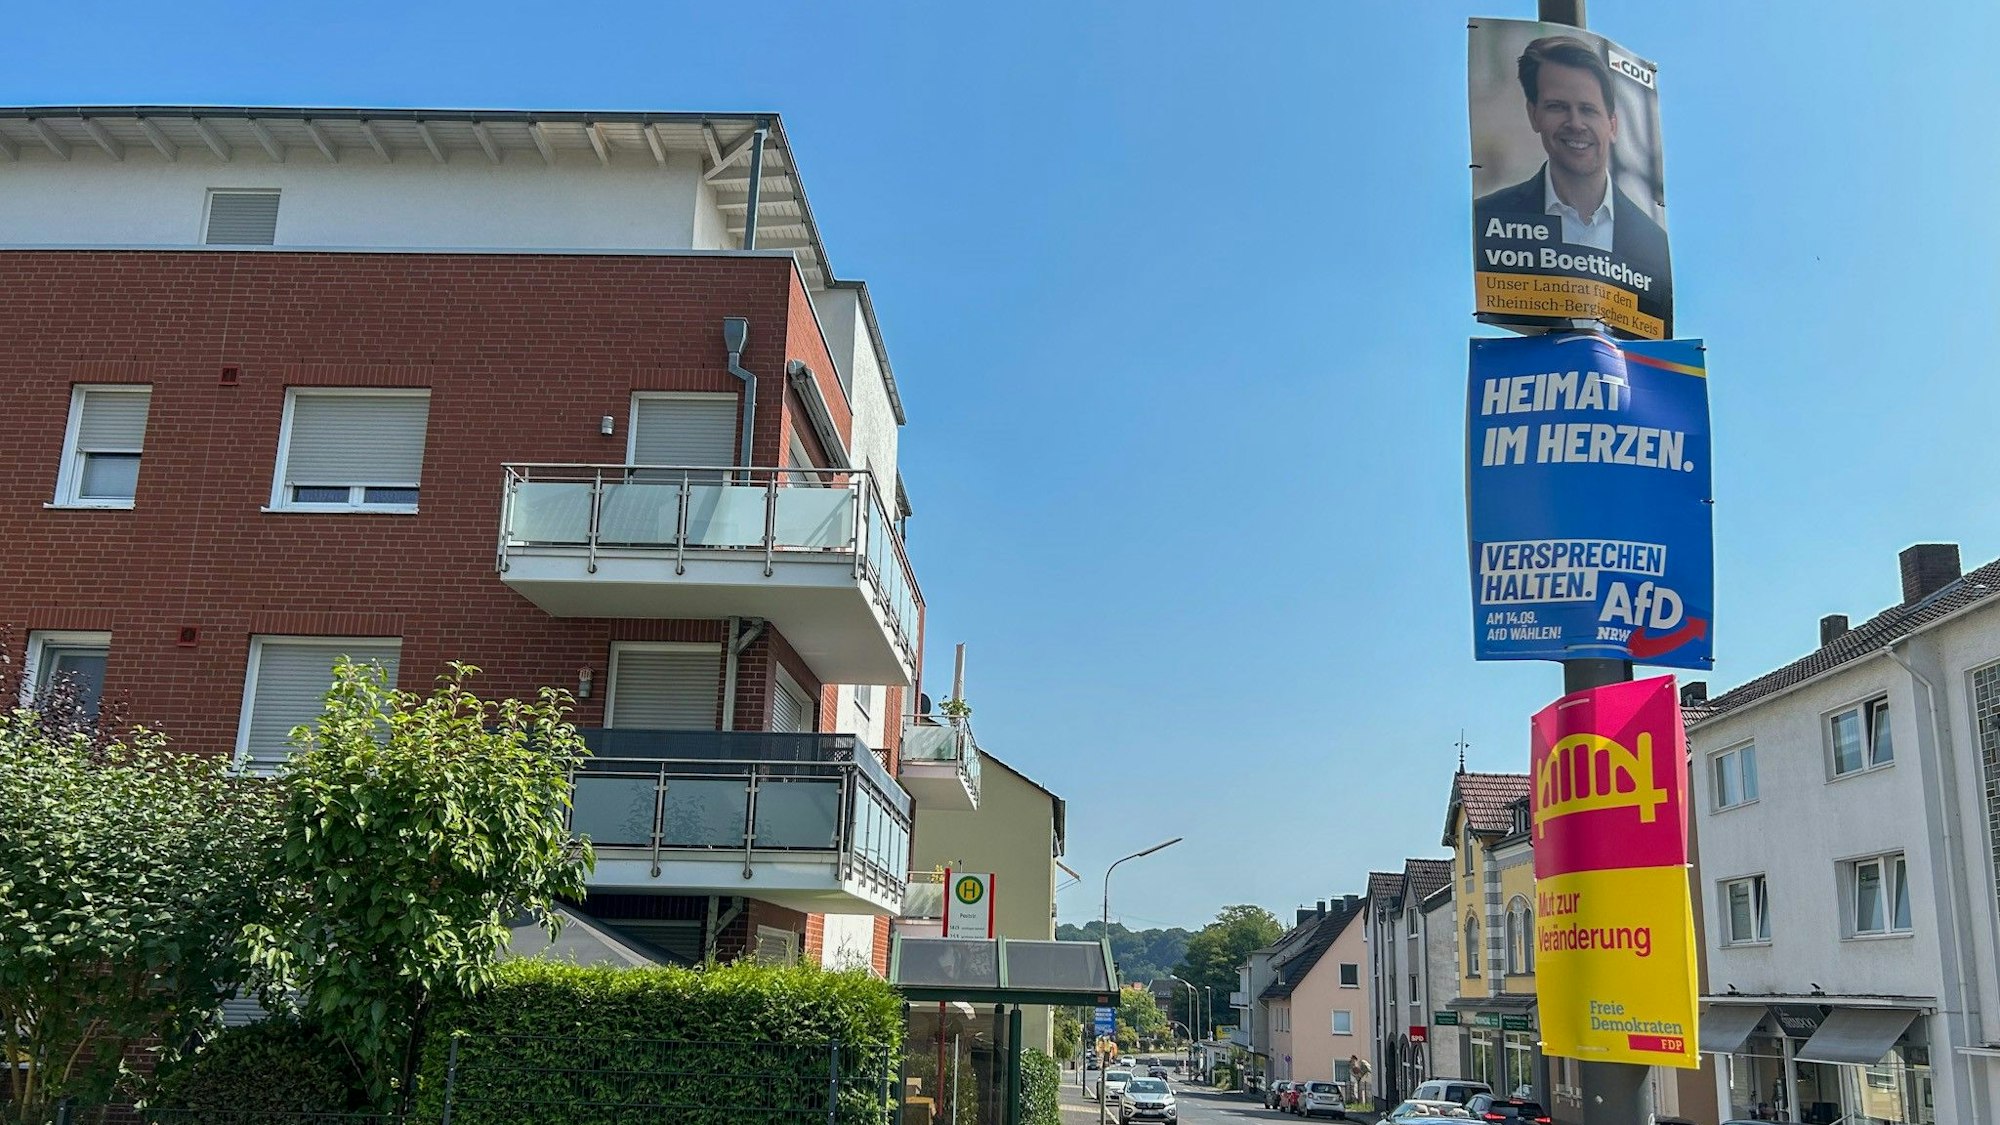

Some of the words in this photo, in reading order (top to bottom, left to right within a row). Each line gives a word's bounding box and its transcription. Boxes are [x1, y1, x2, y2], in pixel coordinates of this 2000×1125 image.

[1621, 60, 1651, 84] CDU
[1485, 218, 1549, 241] Arne
[1485, 249, 1534, 267] von
[1540, 248, 1652, 292] Boetticher
[1486, 277, 1530, 290] Unser
[1534, 280, 1591, 295] Landrat
[1594, 284, 1612, 300] für
[1613, 291, 1632, 308] den
[1486, 295, 1634, 325] Rheinisch-Bergischen
[1632, 316, 1658, 336] Kreis
[1481, 371, 1624, 415] HEIMAT
[1482, 425, 1529, 467] IM
[1537, 423, 1694, 473] HERZEN.
[1486, 543, 1662, 573] VERSPRECHEN
[1485, 571, 1592, 601] HALTEN.
[1486, 612, 1503, 625] AM
[1506, 611, 1538, 624] 14.09.
[1599, 581, 1683, 630] AfD
[1487, 628, 1507, 640] AfD
[1510, 625, 1562, 639] WÄHLEN!
[1596, 626, 1632, 643] NRW
[964, 882, 975, 898] H
[1539, 892, 1554, 918] Mut
[1557, 892, 1580, 915] zur
[1538, 923, 1651, 957] Veränderung
[1590, 1001, 1625, 1015] Freie
[1590, 1016, 1683, 1035] Demokraten
[1661, 1039, 1682, 1051] FDP
